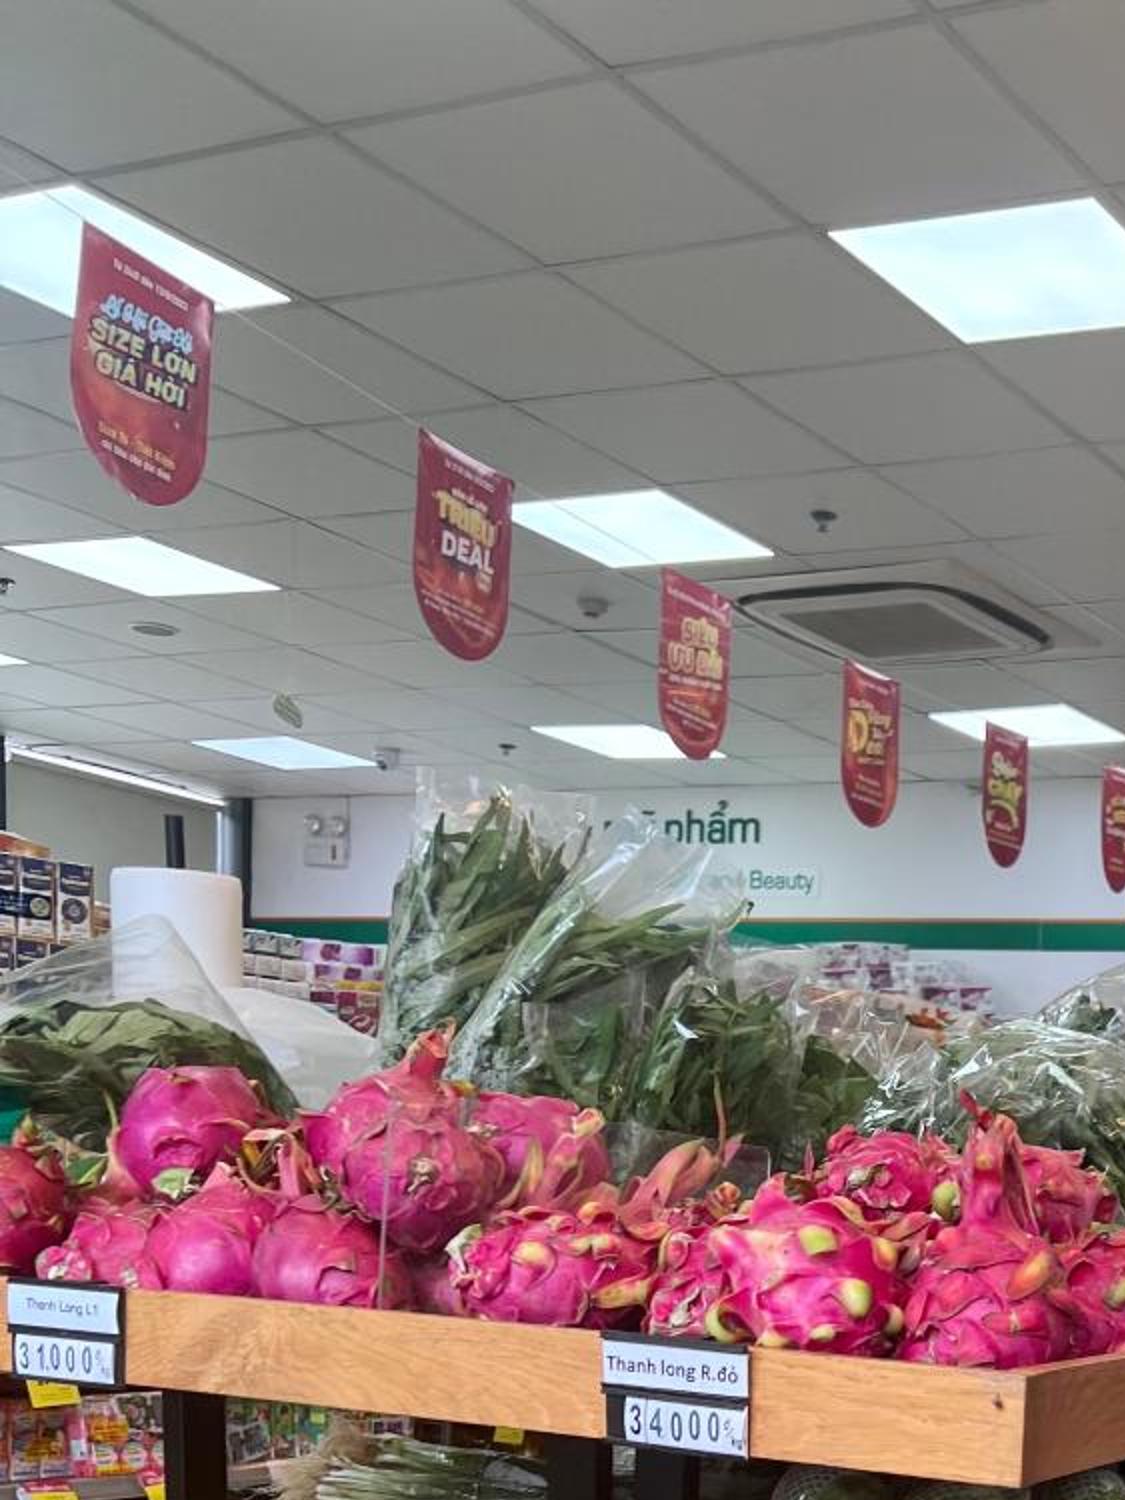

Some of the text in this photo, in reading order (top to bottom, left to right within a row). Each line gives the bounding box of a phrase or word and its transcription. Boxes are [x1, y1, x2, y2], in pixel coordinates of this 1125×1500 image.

[91, 317, 145, 360] SIZE
[96, 351, 138, 387] GIÁ
[440, 529, 495, 576] DEAL
[749, 869, 815, 895] Beauty
[607, 1354, 657, 1375] Thanh
[661, 1359, 696, 1383] long
